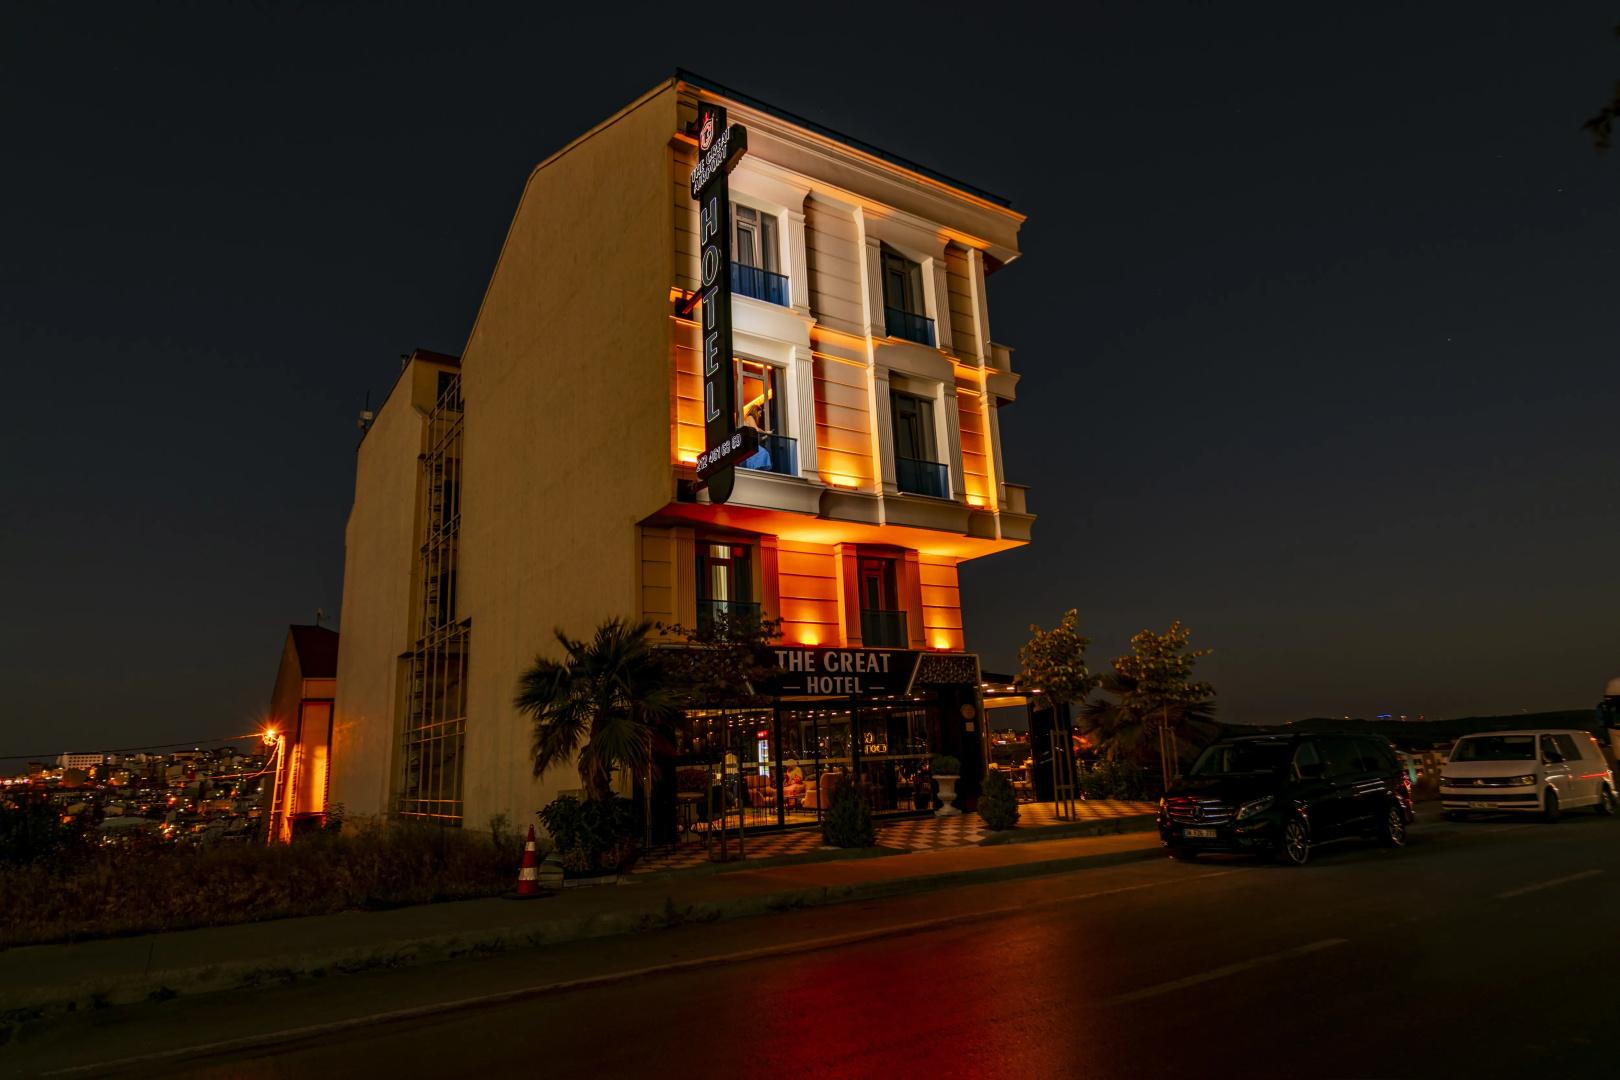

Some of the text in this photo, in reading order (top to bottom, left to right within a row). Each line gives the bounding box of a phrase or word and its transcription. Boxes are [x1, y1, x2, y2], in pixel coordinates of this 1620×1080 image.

[691, 159, 705, 182] THE
[705, 127, 731, 164] GREAT
[693, 144, 727, 194] AIRPORT
[700, 197, 720, 423] HOTEL
[696, 455, 708, 472] 212
[775, 651, 891, 673] THE GREAT
[806, 676, 863, 694] HOTEL
